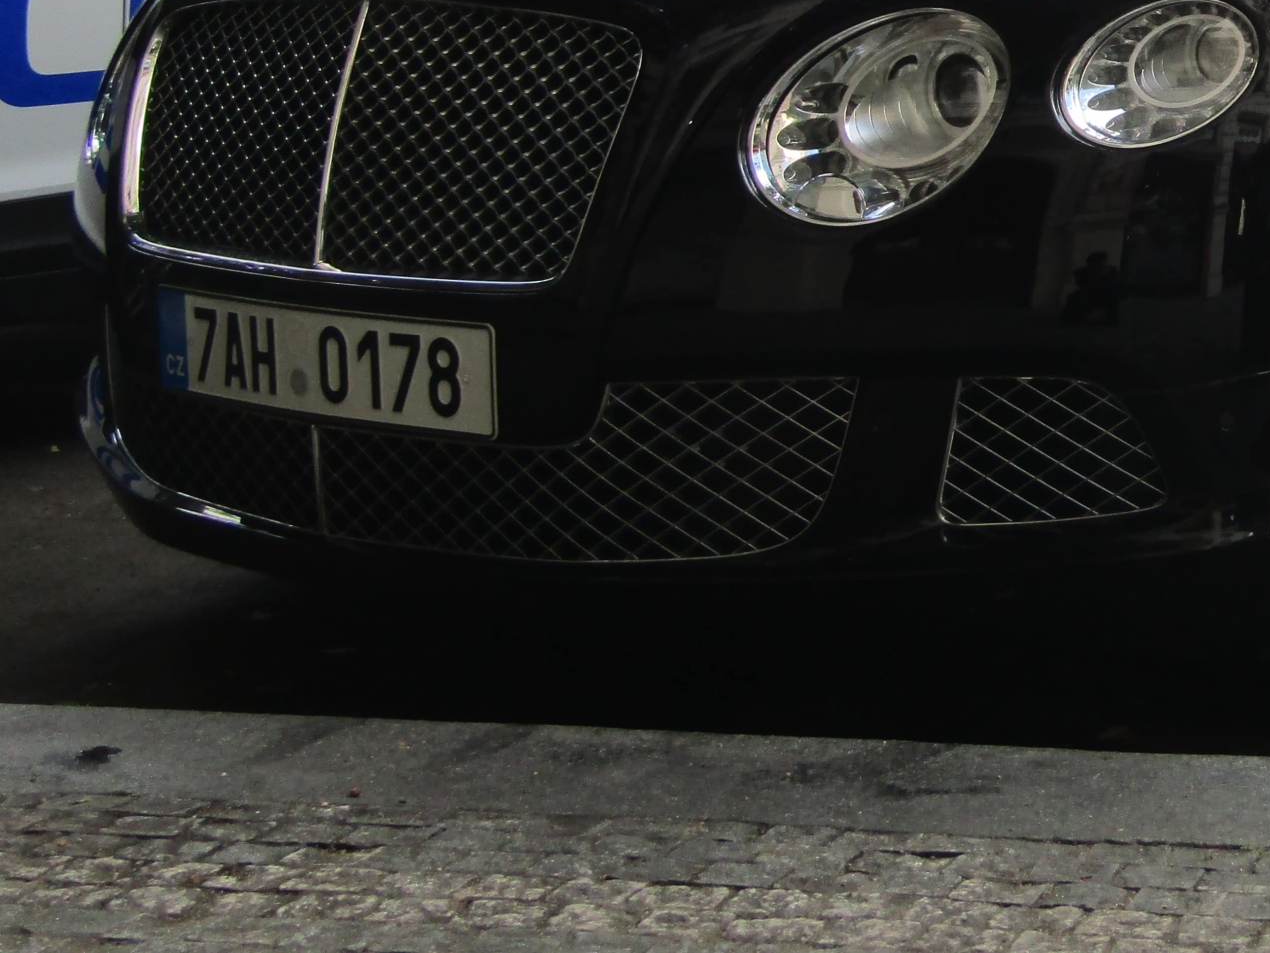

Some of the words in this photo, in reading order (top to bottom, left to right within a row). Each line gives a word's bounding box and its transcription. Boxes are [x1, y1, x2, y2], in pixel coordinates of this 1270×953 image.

[165, 352, 186, 377] CZ
[194, 306, 278, 396] 7AH
[318, 325, 462, 419] 0178
